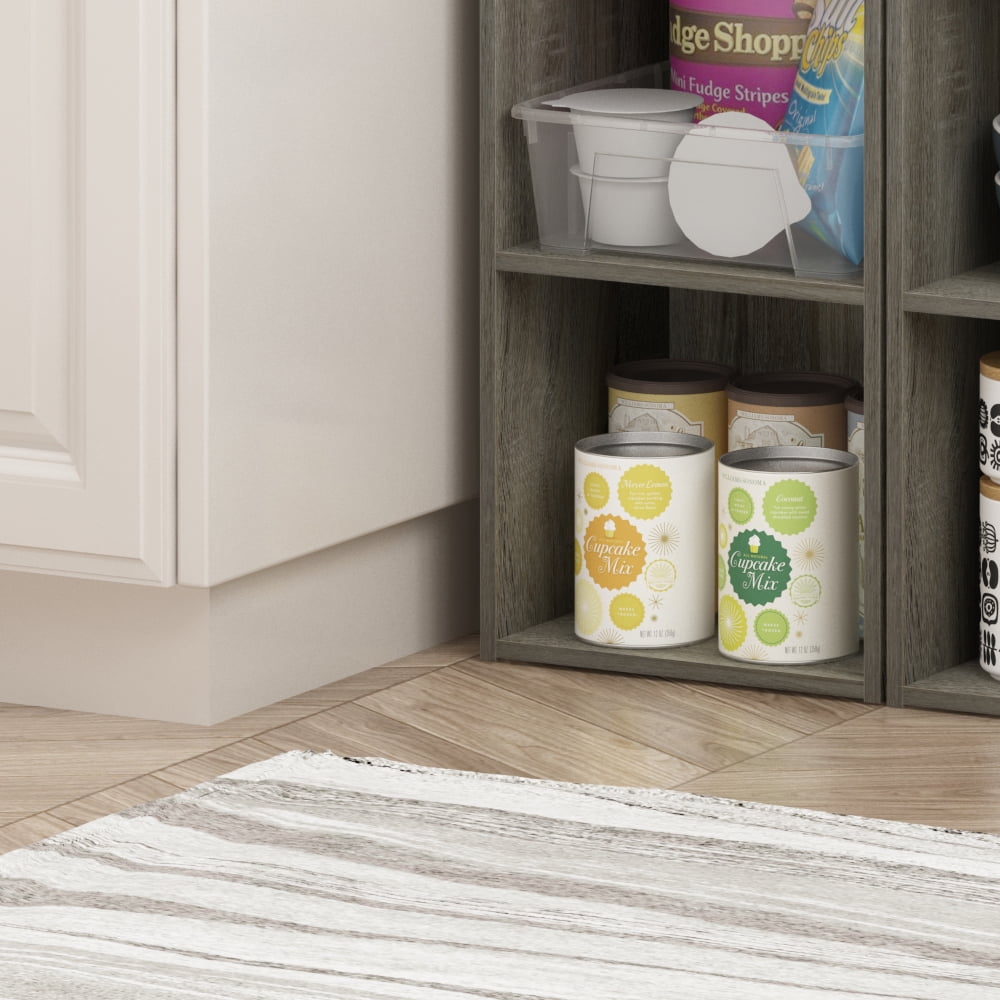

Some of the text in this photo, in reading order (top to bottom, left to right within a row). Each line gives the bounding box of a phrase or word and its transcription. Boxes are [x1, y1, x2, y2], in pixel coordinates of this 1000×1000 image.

[801, 24, 848, 78] Chips
[689, 76, 730, 102] Fudge
[735, 84, 789, 108] Stripes
[585, 536, 641, 557] Cupcake
[600, 556, 635, 575] Mix
[730, 551, 786, 573] Cupcake
[743, 571, 779, 591] Mix
